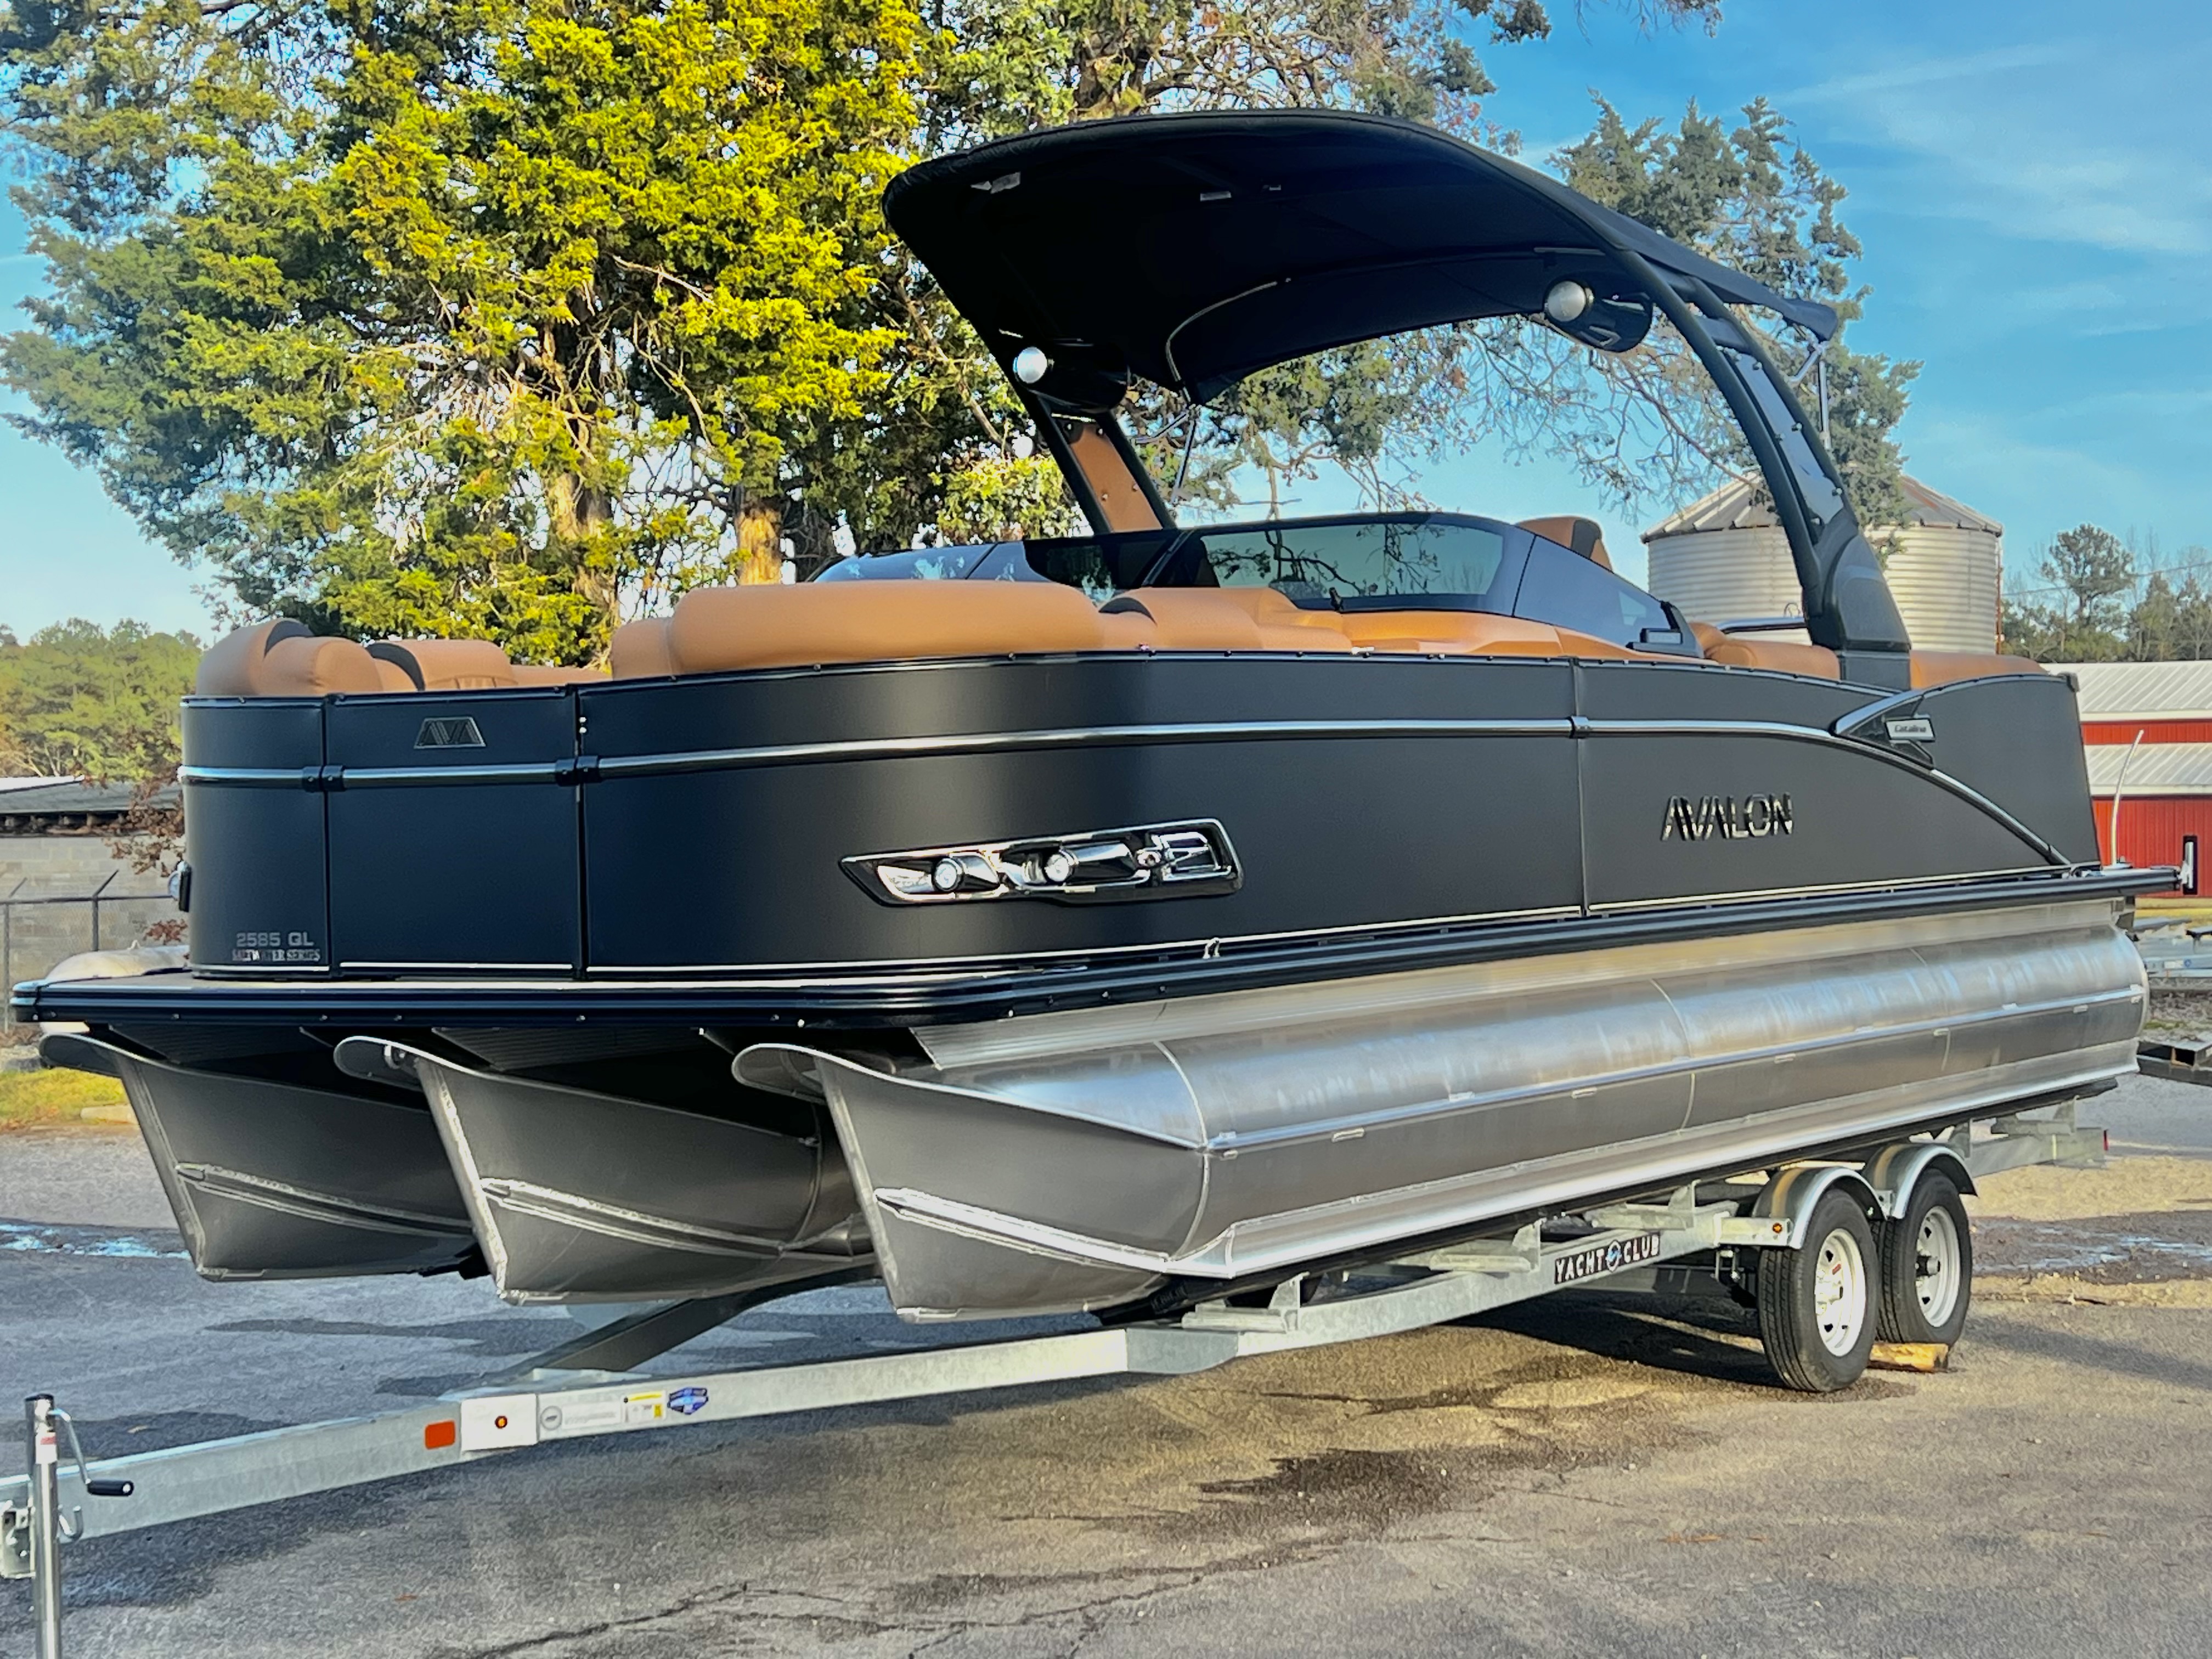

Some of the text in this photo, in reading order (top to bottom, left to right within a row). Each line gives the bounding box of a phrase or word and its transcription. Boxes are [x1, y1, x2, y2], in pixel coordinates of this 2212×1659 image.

[1661, 792, 1793, 840] AVALON
[236, 932, 281, 947] 2585
[1556, 1235, 1660, 1283] YACHT CLUB
